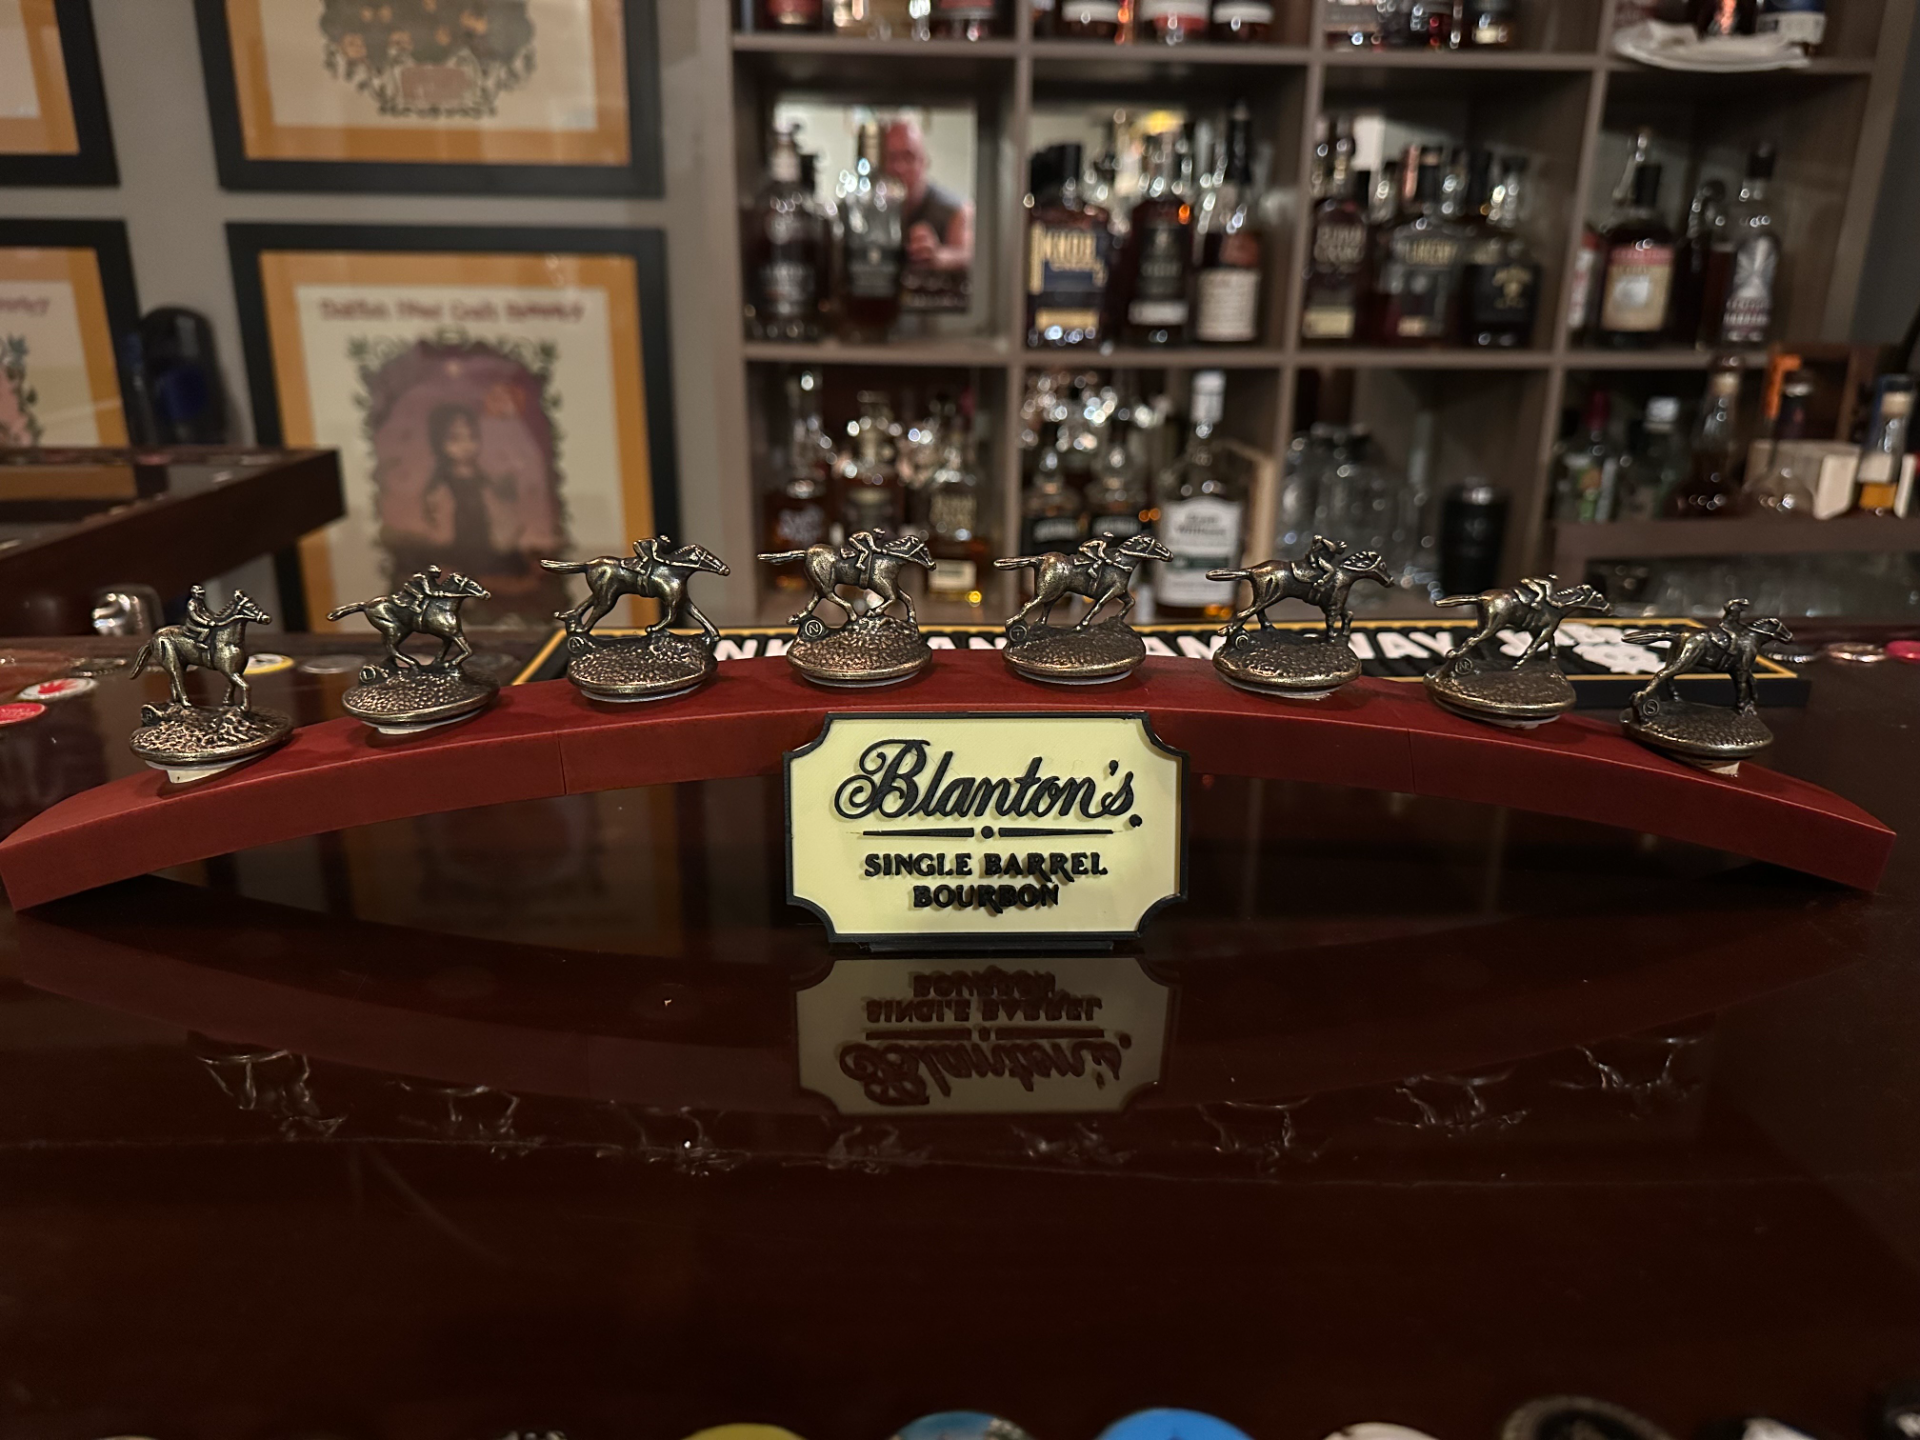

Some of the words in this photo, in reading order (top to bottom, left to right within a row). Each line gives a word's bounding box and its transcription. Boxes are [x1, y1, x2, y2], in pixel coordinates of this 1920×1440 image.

[864, 852, 973, 877] SINGLE
[984, 851, 1109, 882] BARREL
[913, 883, 1060, 914] BOURBON
